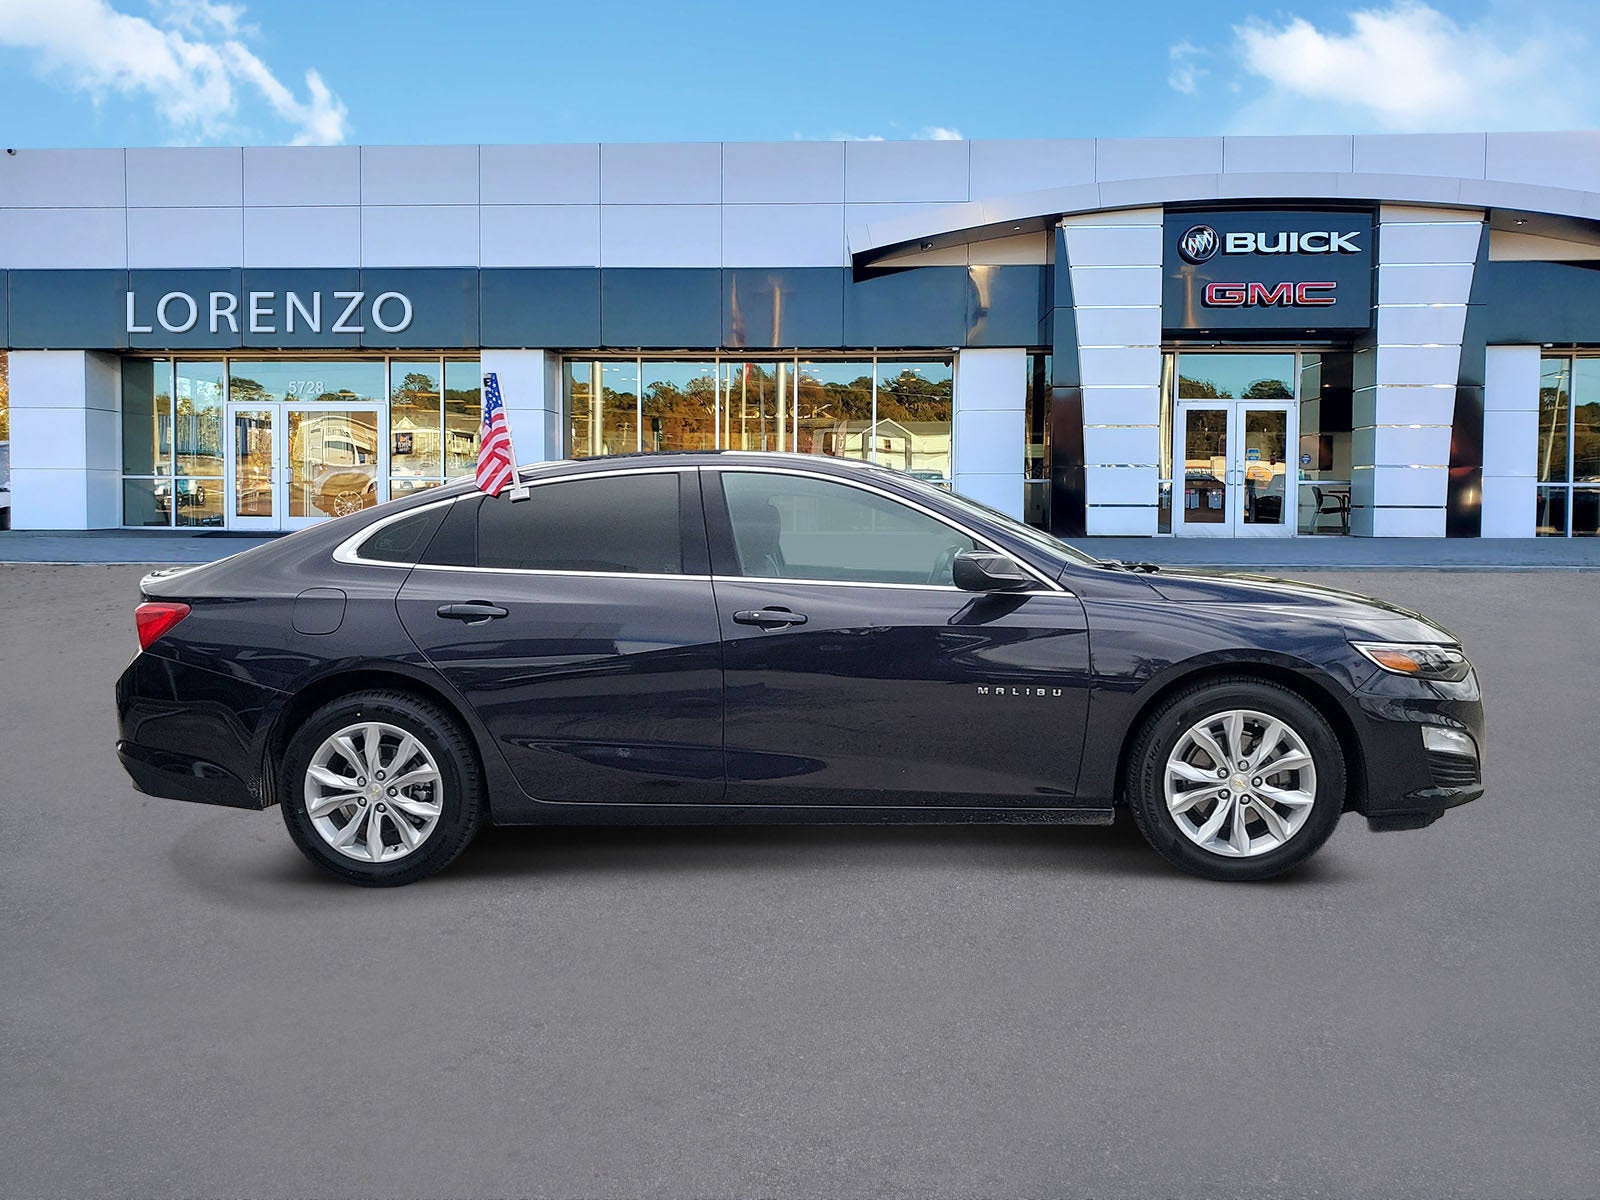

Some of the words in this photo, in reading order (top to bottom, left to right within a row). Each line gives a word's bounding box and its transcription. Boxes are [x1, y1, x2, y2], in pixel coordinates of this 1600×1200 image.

[1226, 231, 1362, 253] BUICK
[1205, 281, 1337, 305] GMC
[126, 291, 413, 333] LORENZO
[288, 381, 325, 394] 5728
[738, 402, 834, 419] BCK
[977, 686, 1062, 696] MALIBU
